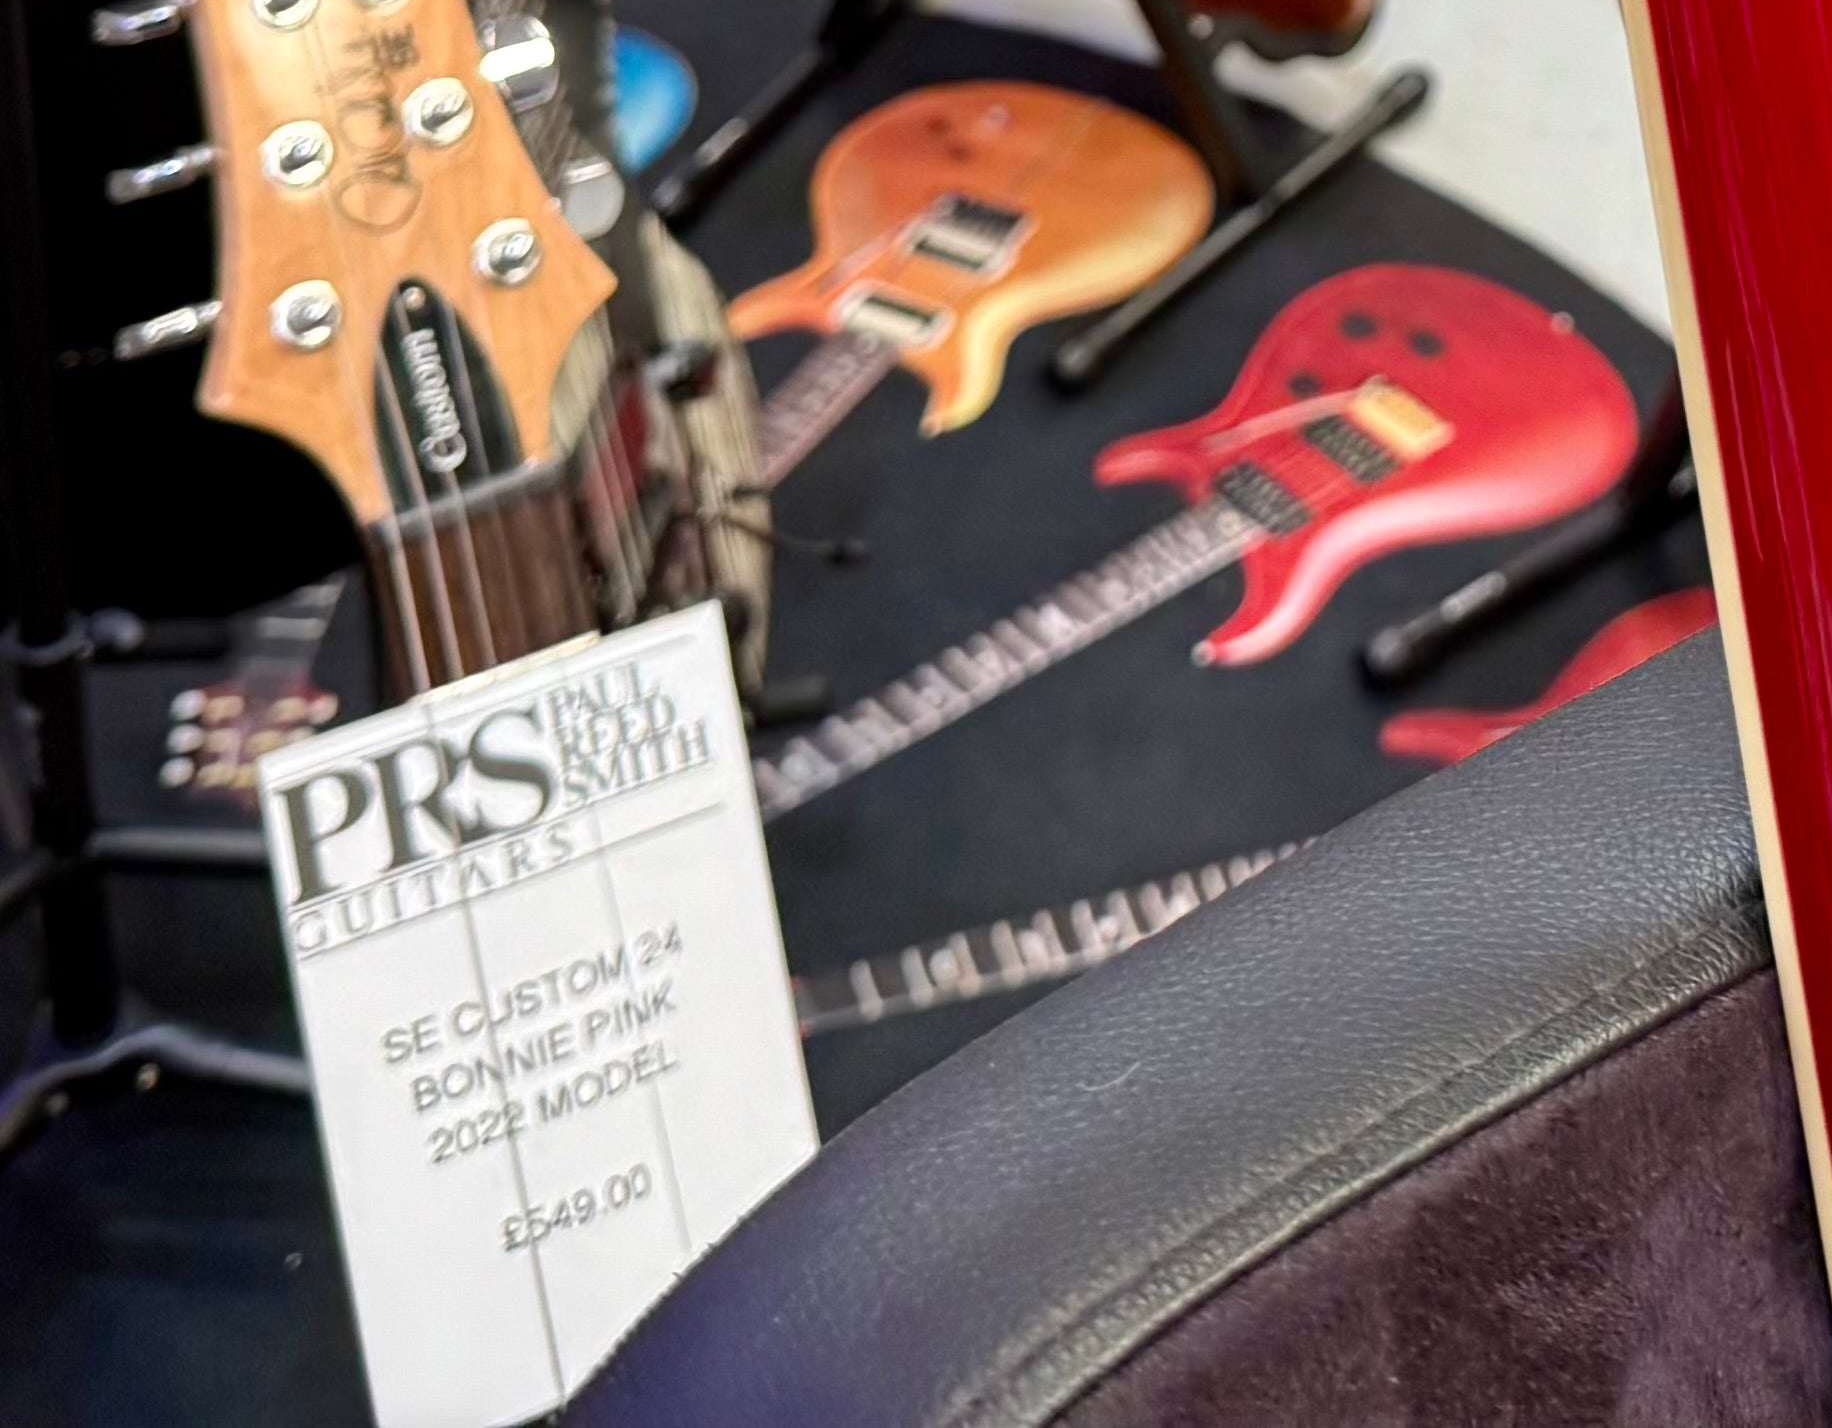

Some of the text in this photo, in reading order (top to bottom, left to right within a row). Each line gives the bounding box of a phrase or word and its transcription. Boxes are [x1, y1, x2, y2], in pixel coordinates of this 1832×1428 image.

[402, 328, 467, 473] Custom
[548, 663, 646, 718] PAUL
[553, 693, 677, 758] REED
[274, 706, 555, 902] PRS
[562, 717, 709, 802] SMITH
[293, 830, 574, 951] GUITARS
[381, 921, 683, 1064] SE CUSTOM 24
[411, 978, 677, 1112] BONNIE PINK
[427, 1041, 680, 1164] 2022 MODEL
[501, 1163, 652, 1253] £549.00
